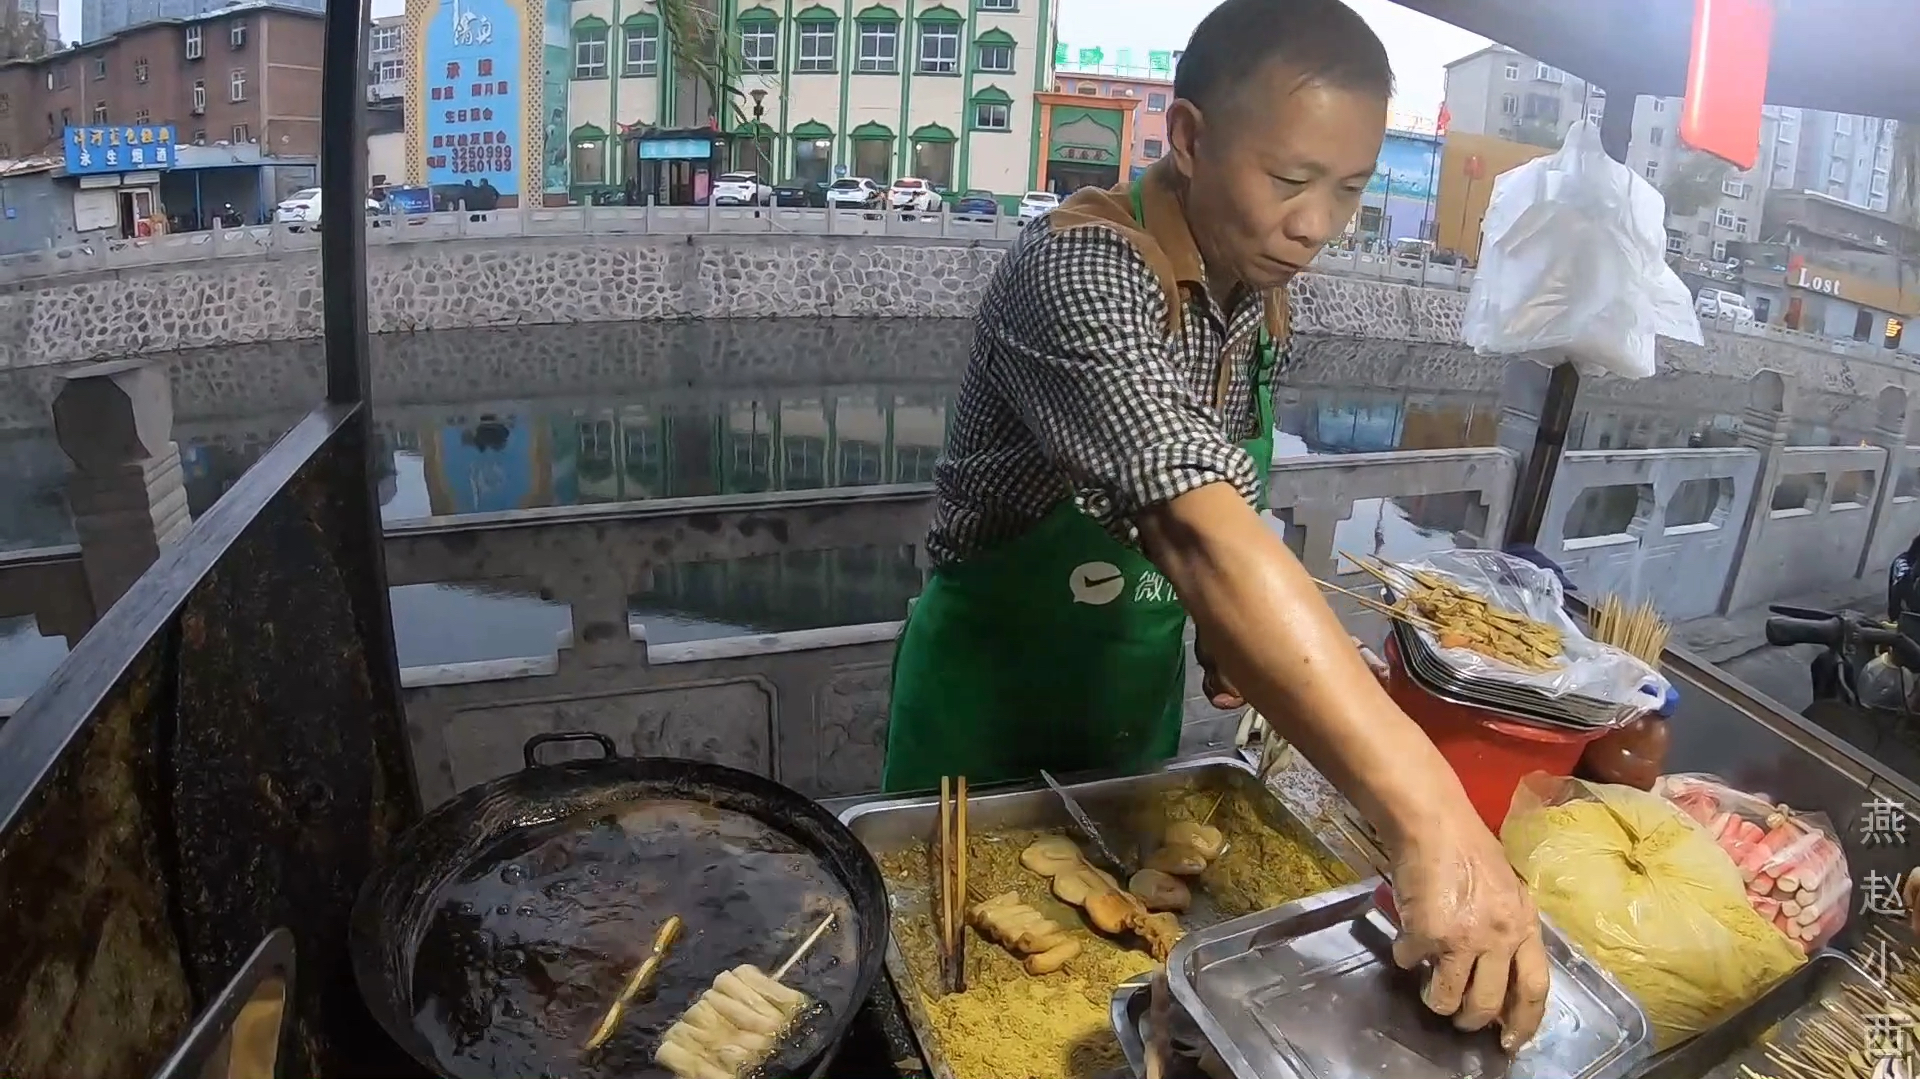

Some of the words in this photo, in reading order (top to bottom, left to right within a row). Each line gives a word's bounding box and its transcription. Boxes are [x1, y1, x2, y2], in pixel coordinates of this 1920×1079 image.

[451, 145, 512, 161] 3250999
[451, 159, 512, 174] 3250199
[1798, 267, 1840, 295] Lost
